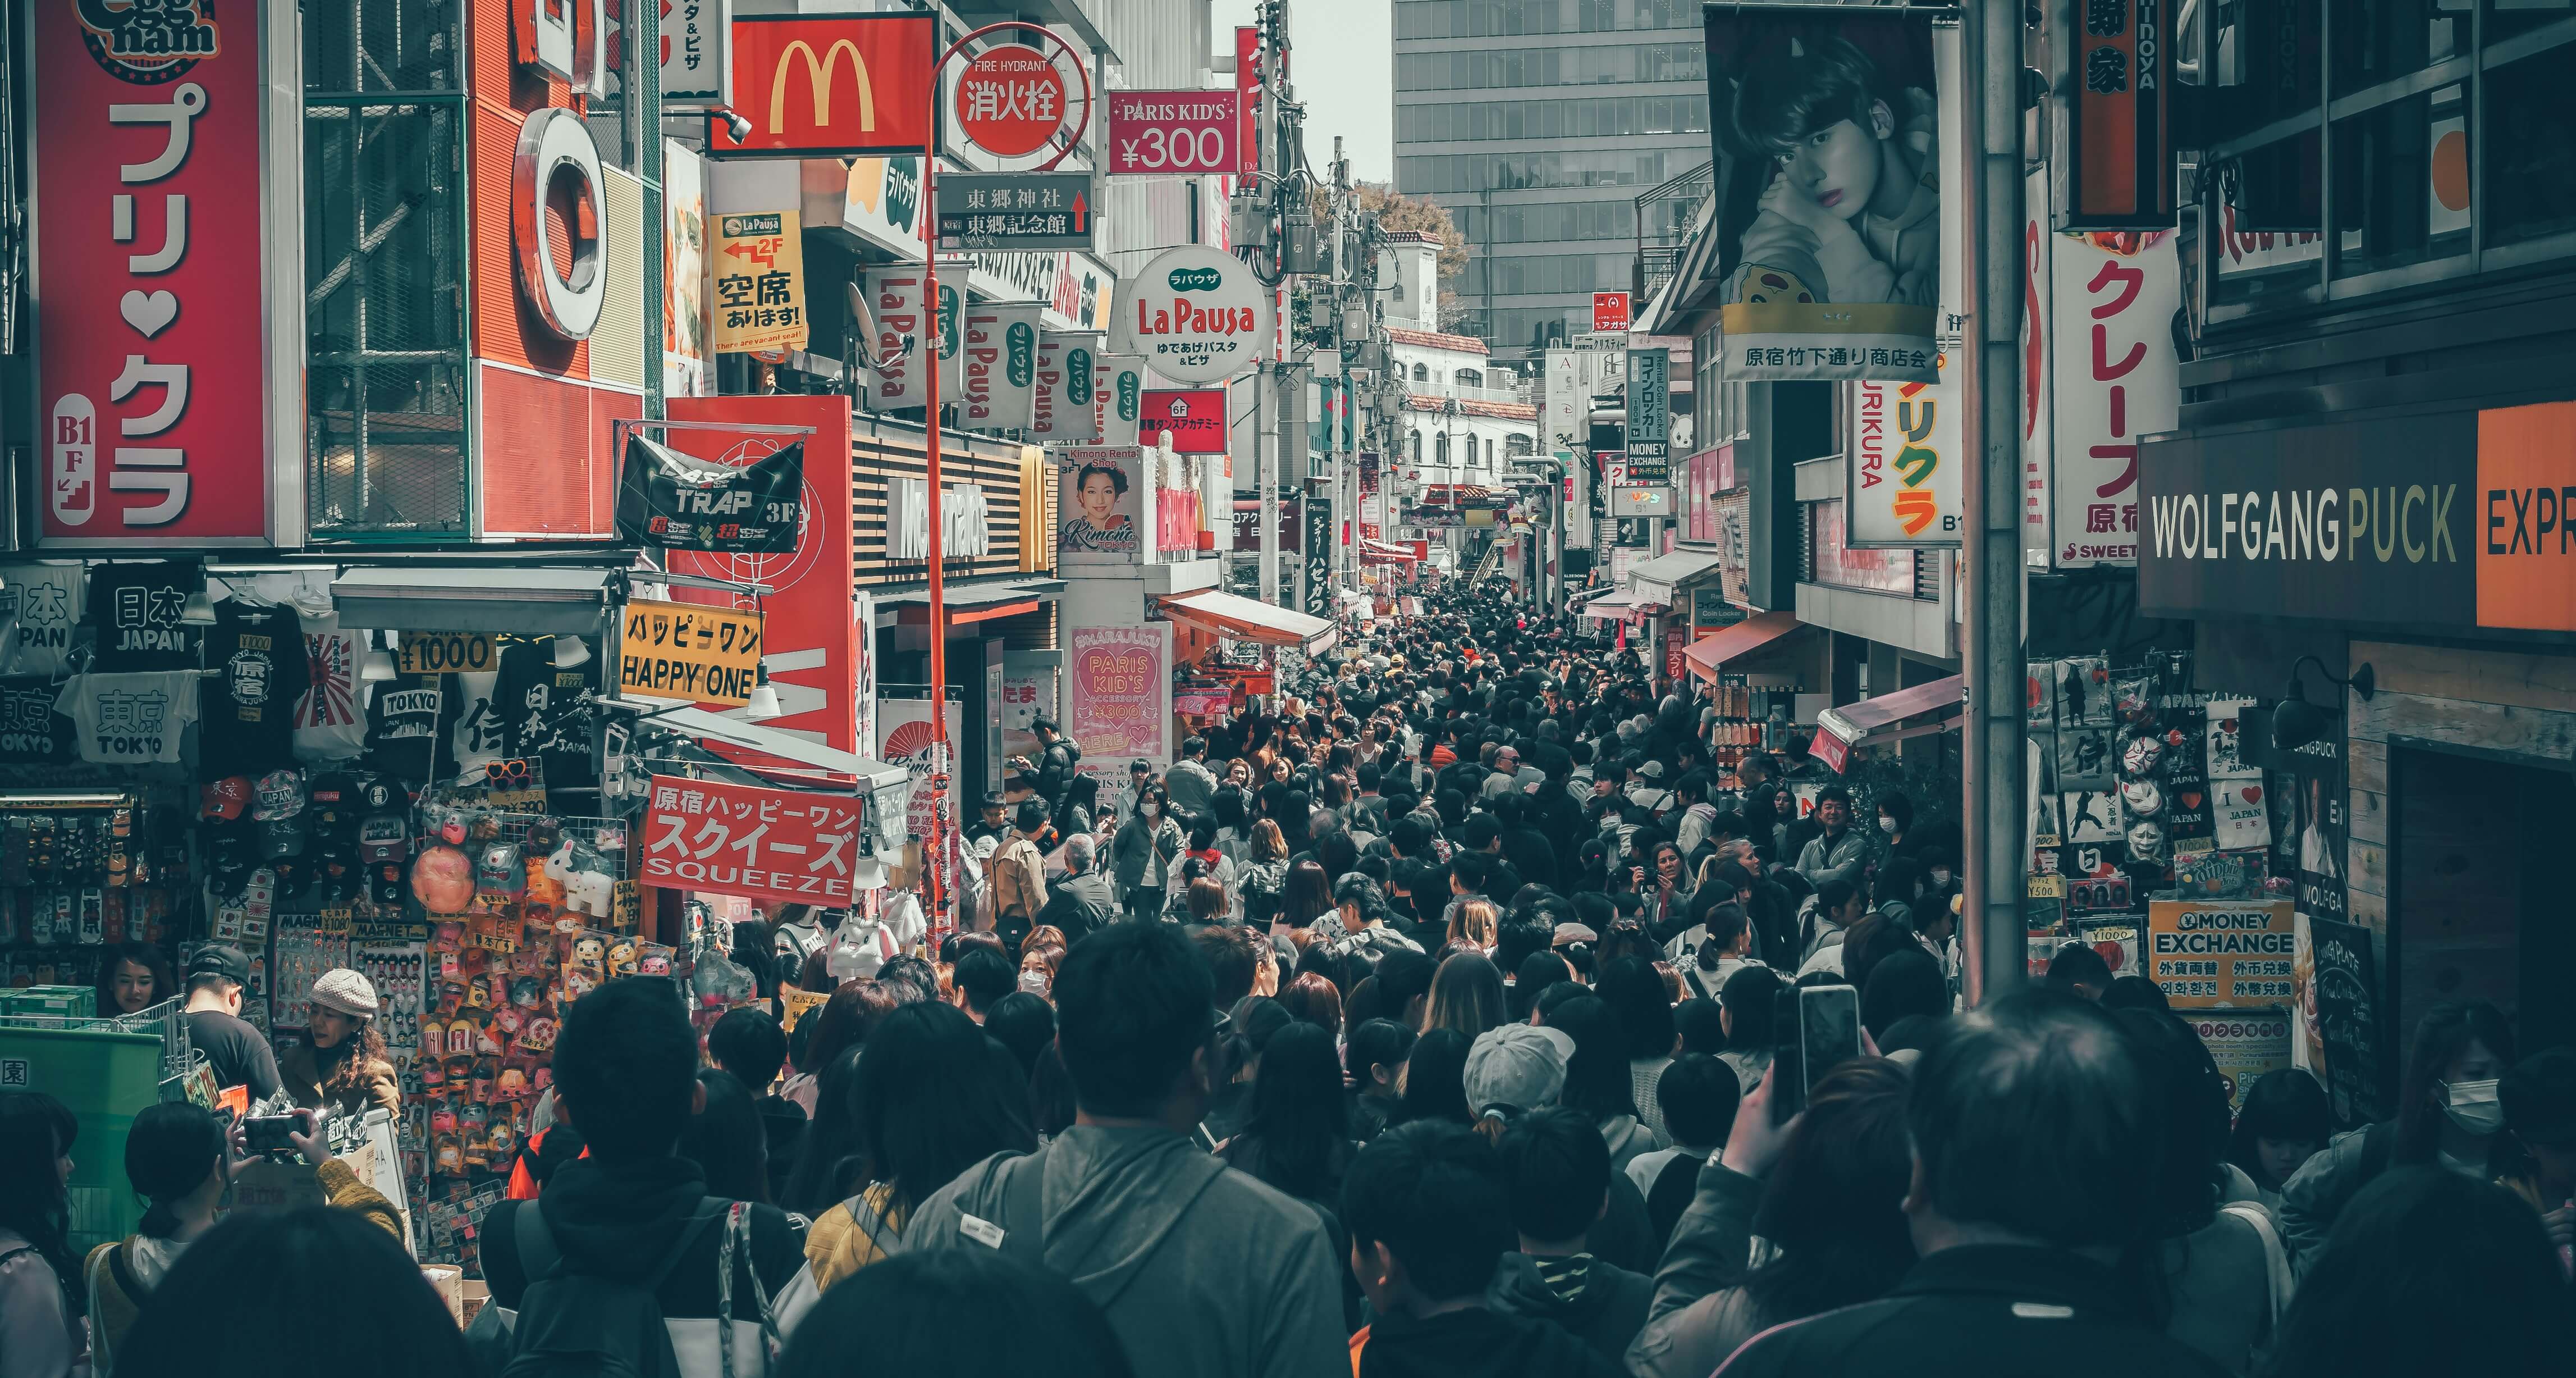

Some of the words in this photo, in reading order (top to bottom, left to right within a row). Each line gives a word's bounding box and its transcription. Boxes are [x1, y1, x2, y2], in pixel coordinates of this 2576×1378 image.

[111, 26, 216, 54] nam
[683, 0, 701, 71] タ&ピザ
[974, 60, 997, 72] FIRE
[1000, 60, 1047, 72] HYDRANT
[967, 80, 1058, 121] 消火栓
[1123, 99, 1174, 120] PARIS
[1178, 104, 1225, 120] KID'S
[1121, 127, 1224, 168] ¥300
[887, 167, 917, 209] ラパウザ
[966, 188, 1061, 209] 東郷神社
[966, 215, 1067, 235] 東郷記念館
[759, 238, 784, 254] 2F
[718, 270, 791, 308] 空席
[1170, 273, 1219, 285] ラパウザ
[716, 341, 738, 350] There
[754, 334, 780, 345] vacant
[1157, 341, 1237, 354] ゆであげパスタ
[1593, 339, 1626, 351] クリスティー
[1014, 325, 1028, 386] ラパウザ
[1179, 355, 1209, 366] &ピザ
[1745, 347, 1927, 369] 原宿竹下通り商店会
[1072, 351, 1086, 404] ラパウザ
[1123, 373, 1133, 419] ラパウザ
[1642, 356, 1654, 437] コインロッカー
[1172, 405, 1186, 416] 6F
[57, 416, 91, 445] B1
[1861, 380, 1883, 489] URIKURA
[1630, 444, 1666, 455] MONEY
[65, 451, 83, 472] F
[1092, 459, 1117, 468] Shop
[1630, 457, 1666, 466] EXCHANGE
[676, 489, 753, 514] TRAP
[766, 502, 795, 522] 3F
[1064, 517, 1137, 551] Kimono
[1307, 557, 1327, 614] ハセガワ
[116, 586, 185, 628] 日本
[116, 630, 185, 652] JAPAN
[628, 613, 759, 655] ハッピーワン
[1074, 631, 1160, 649] #HARAJUKU
[228, 649, 249, 667] TOKYO
[254, 651, 274, 671] JAPAN
[401, 636, 489, 671] ¥1000
[1090, 656, 1148, 674] PARIS
[235, 661, 266, 696] 原宿
[621, 655, 702, 693] HAPPY
[706, 664, 755, 700] ONE
[1093, 676, 1144, 693] KID'S
[230, 691, 268, 705] HARAJUKU
[387, 692, 437, 713] TOKYO
[2161, 694, 2206, 708] APAN
[96, 690, 168, 733] 東京
[1095, 704, 1141, 719] ¥300
[1, 733, 54, 754] OKYO
[96, 736, 163, 755] TOKYO
[1078, 732, 1124, 750] HERE
[2227, 764, 2255, 773] JAPAN
[2170, 775, 2200, 785] JAPAN
[262, 788, 292, 805] JAPAN
[2222, 792, 2232, 807] I
[653, 786, 857, 828] 原宿ハッピーワン
[2107, 807, 2117, 826] 忍者
[2229, 808, 2261, 820] JAPAN
[2171, 814, 2202, 823] JAPAN
[649, 814, 854, 877] スクイーズ
[646, 858, 850, 898] SQUEEZE
[2198, 914, 2272, 929] MONEY
[2093, 931, 2127, 941] ¥1000
[2156, 934, 2294, 953] EXCHANGE
[2159, 961, 2218, 975] 外貨両替
[2234, 961, 2291, 975] 外币兑换
[2161, 982, 2217, 996] 외화환전
[2194, 1024, 2284, 1036] リクラ専門店
